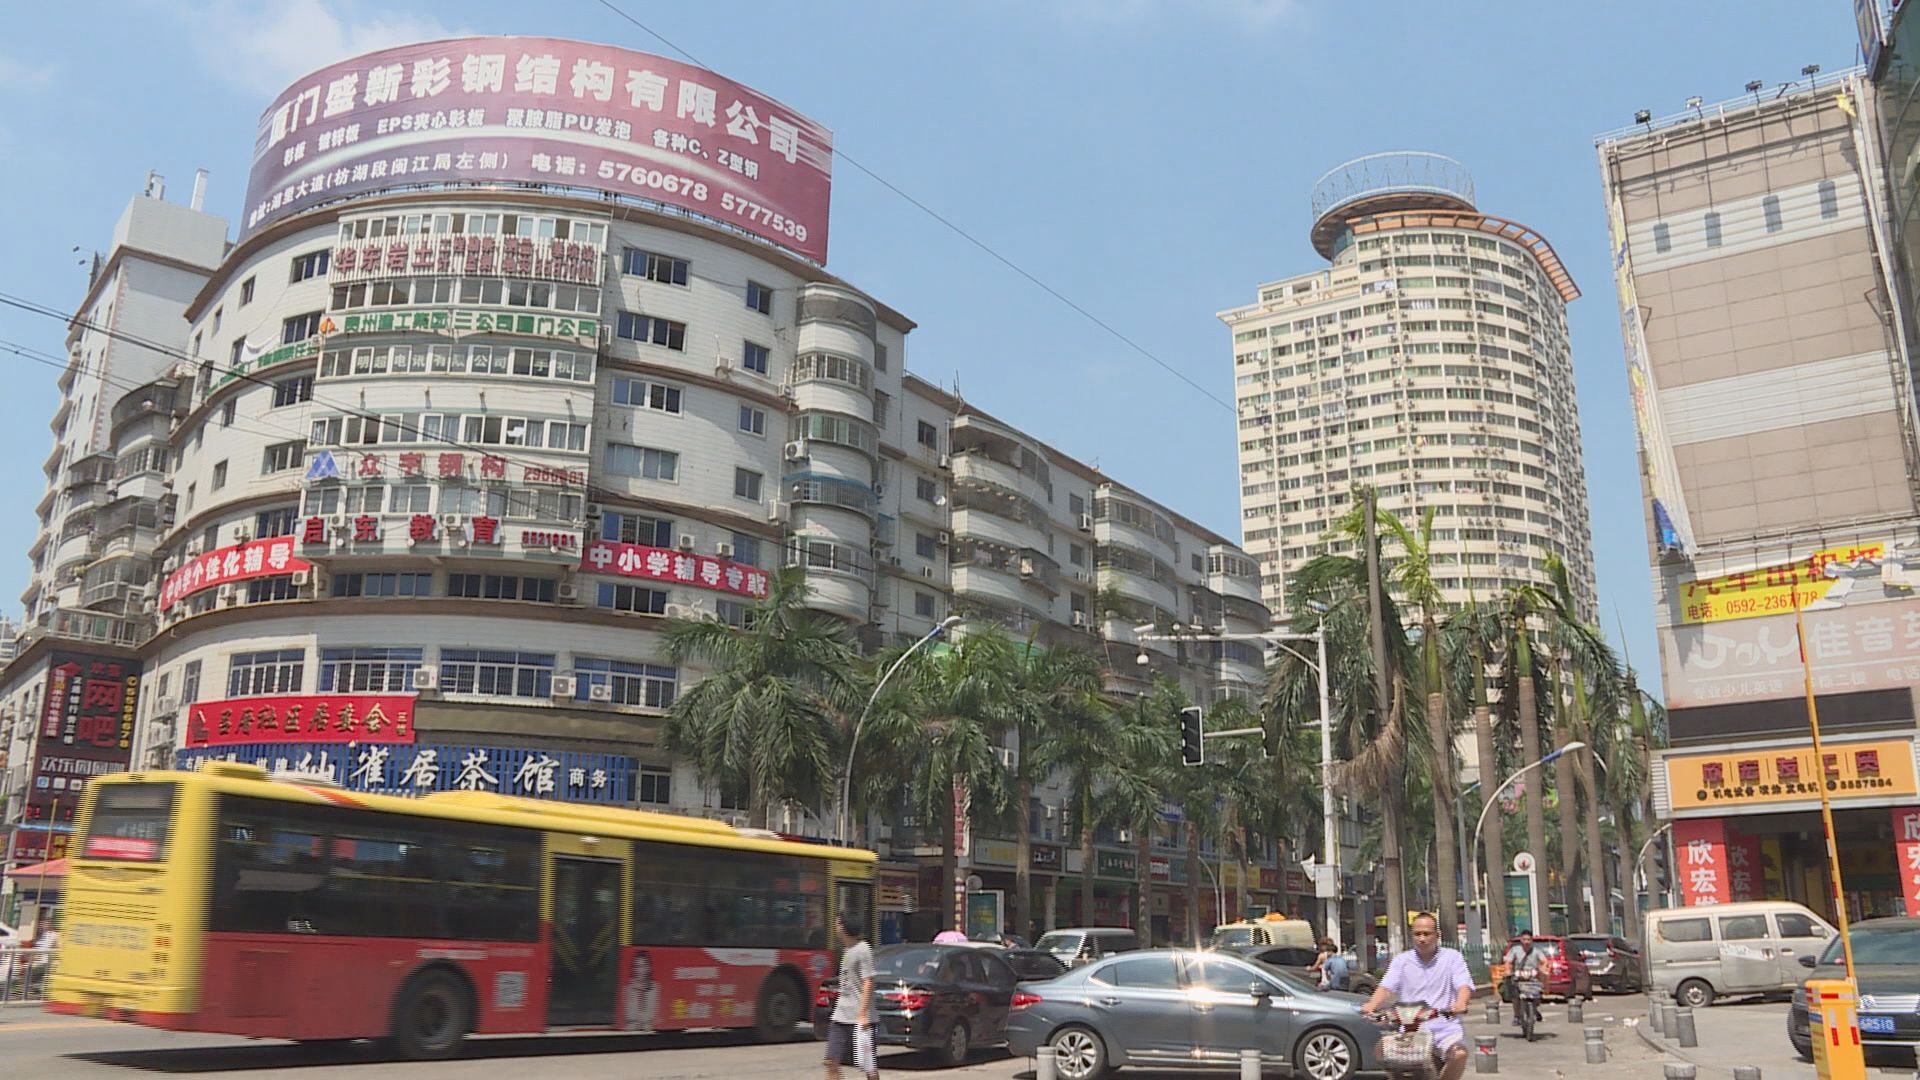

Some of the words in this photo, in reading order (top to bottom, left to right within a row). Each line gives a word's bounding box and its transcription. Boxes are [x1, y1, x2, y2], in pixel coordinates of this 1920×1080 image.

[597, 160, 708, 202] 5760678
[721, 192, 807, 242] 5777539
[335, 241, 433, 275] 华东岩土
[77, 678, 122, 747] 网吧
[569, 767, 608, 788] 商务
